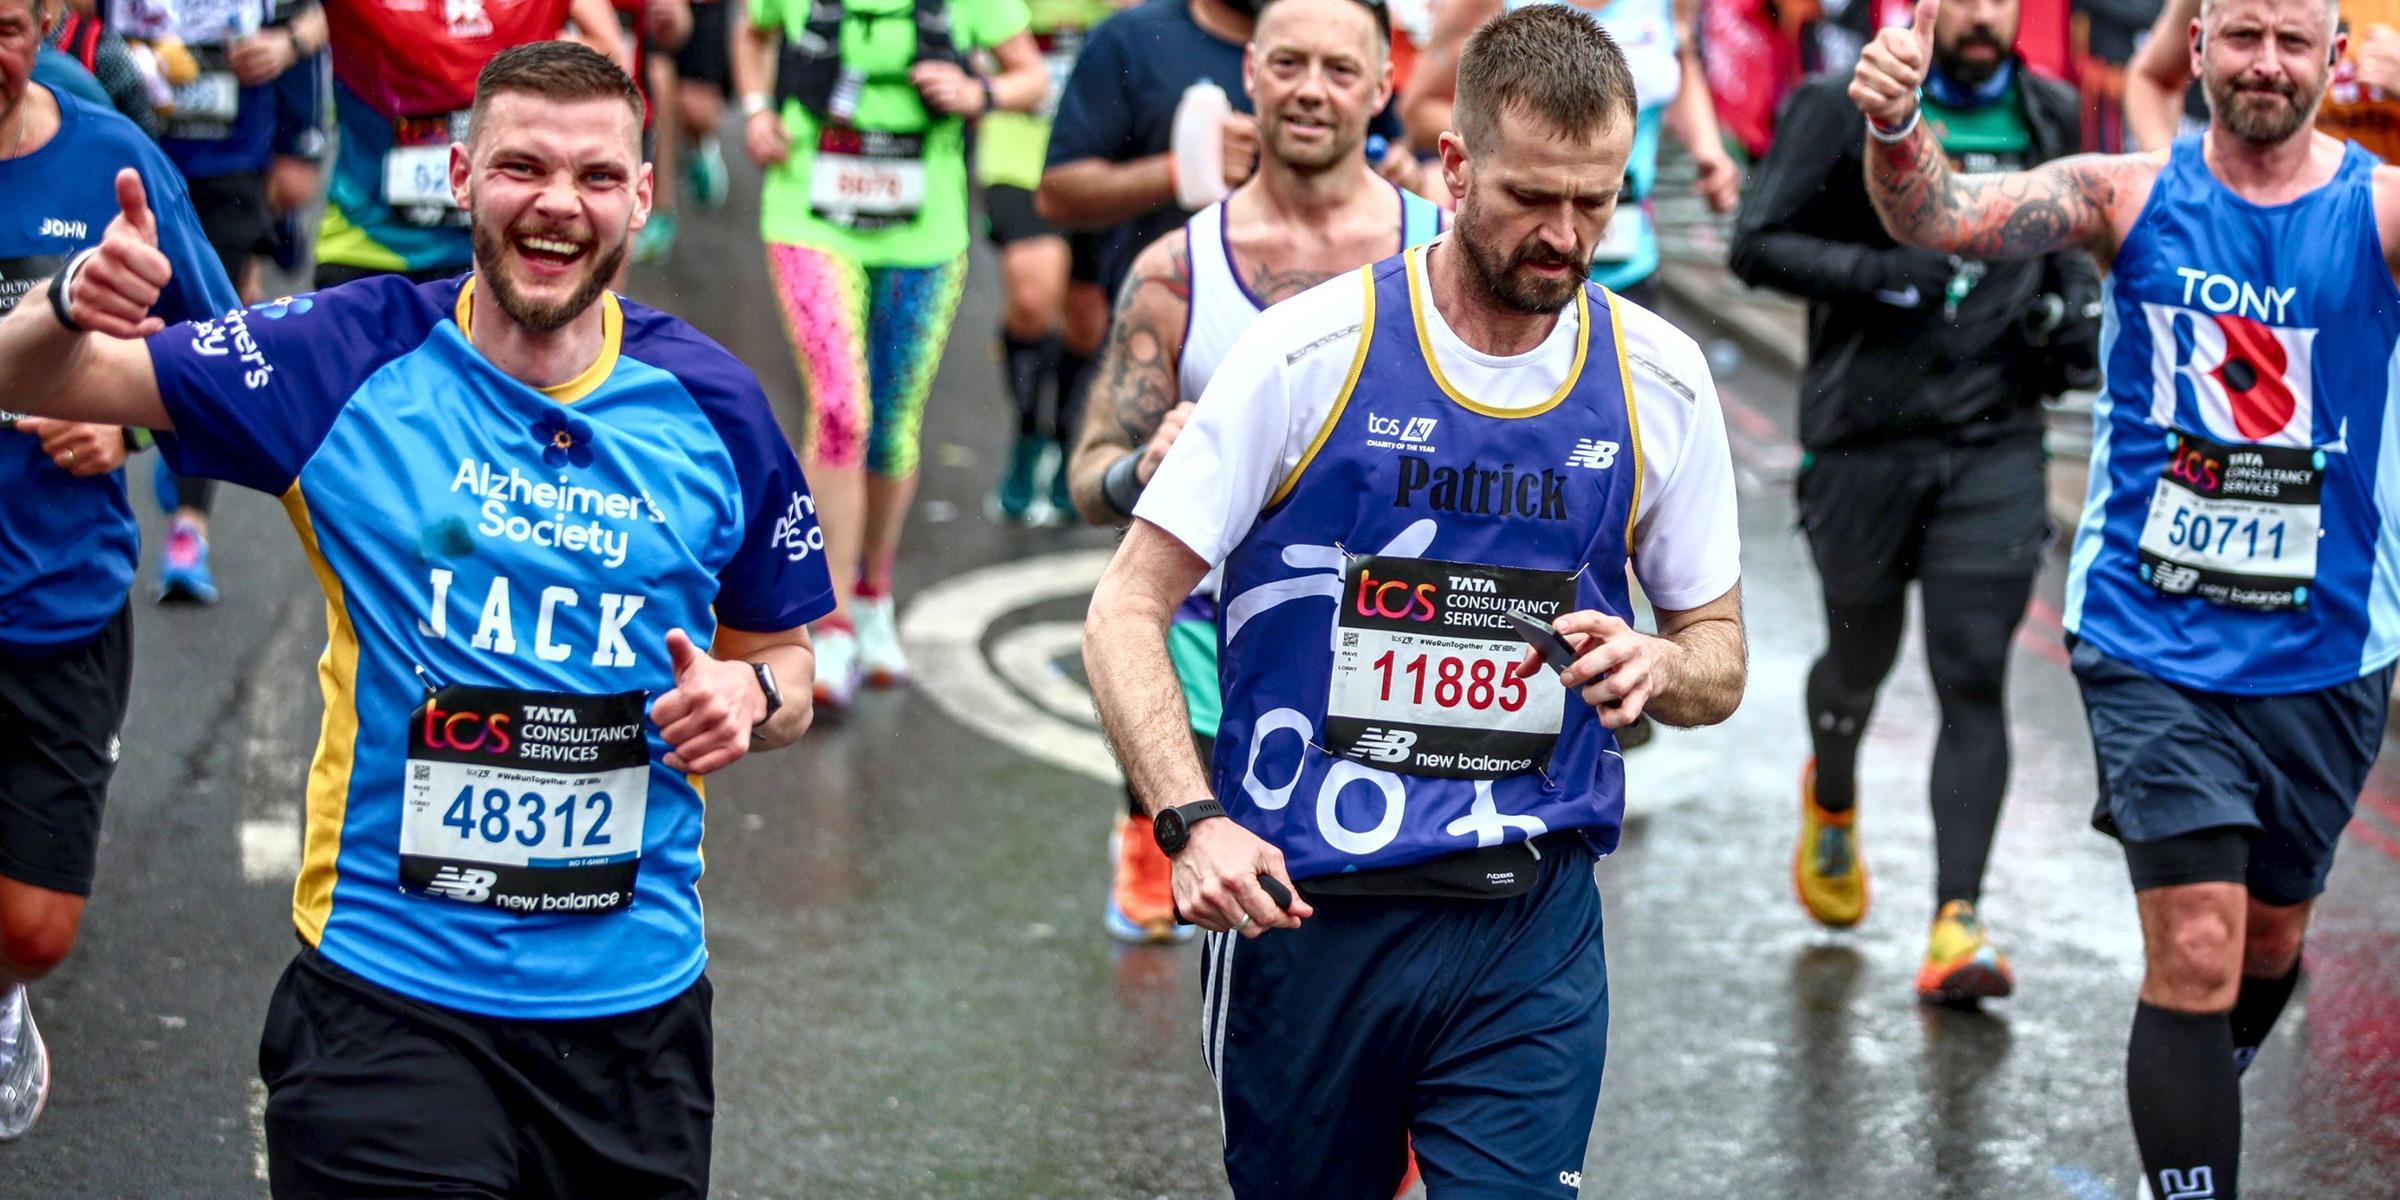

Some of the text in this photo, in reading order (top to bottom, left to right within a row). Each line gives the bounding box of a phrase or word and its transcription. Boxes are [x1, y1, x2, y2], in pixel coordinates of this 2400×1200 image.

[40, 217, 87, 240] JOHN
[2176, 266, 2297, 324] TONY
[1367, 412, 1400, 436] tcs
[1367, 439, 1436, 453] CHARITY OF THE YEAR
[2228, 452, 2264, 466] TATA
[2224, 467, 2313, 485] CONSULTANCY
[451, 458, 666, 524] Alzheimer's
[1393, 454, 1568, 520] Patrick
[2222, 481, 2280, 497] SERVICES
[478, 499, 629, 568] Society
[2169, 504, 2286, 560] 50711
[1448, 576, 1497, 593] TATA
[2197, 581, 2293, 605] new balance
[1356, 569, 1437, 622] tcs
[1446, 594, 1560, 615] CONSULTANCY
[418, 568, 646, 668] JACK
[1420, 638, 1483, 651] #WeRunTogether
[1373, 650, 1528, 713] 11885
[523, 705, 577, 724] TATA
[423, 698, 511, 753] tcs
[520, 723, 640, 744] CONSULTANCY
[519, 743, 600, 762] SERVICES
[1416, 751, 1532, 772] new balance
[497, 773, 568, 785] #WeRunTogether
[443, 784, 613, 848] 48312
[581, 857, 609, 866] T-SHIRT
[497, 890, 620, 911] new balance
